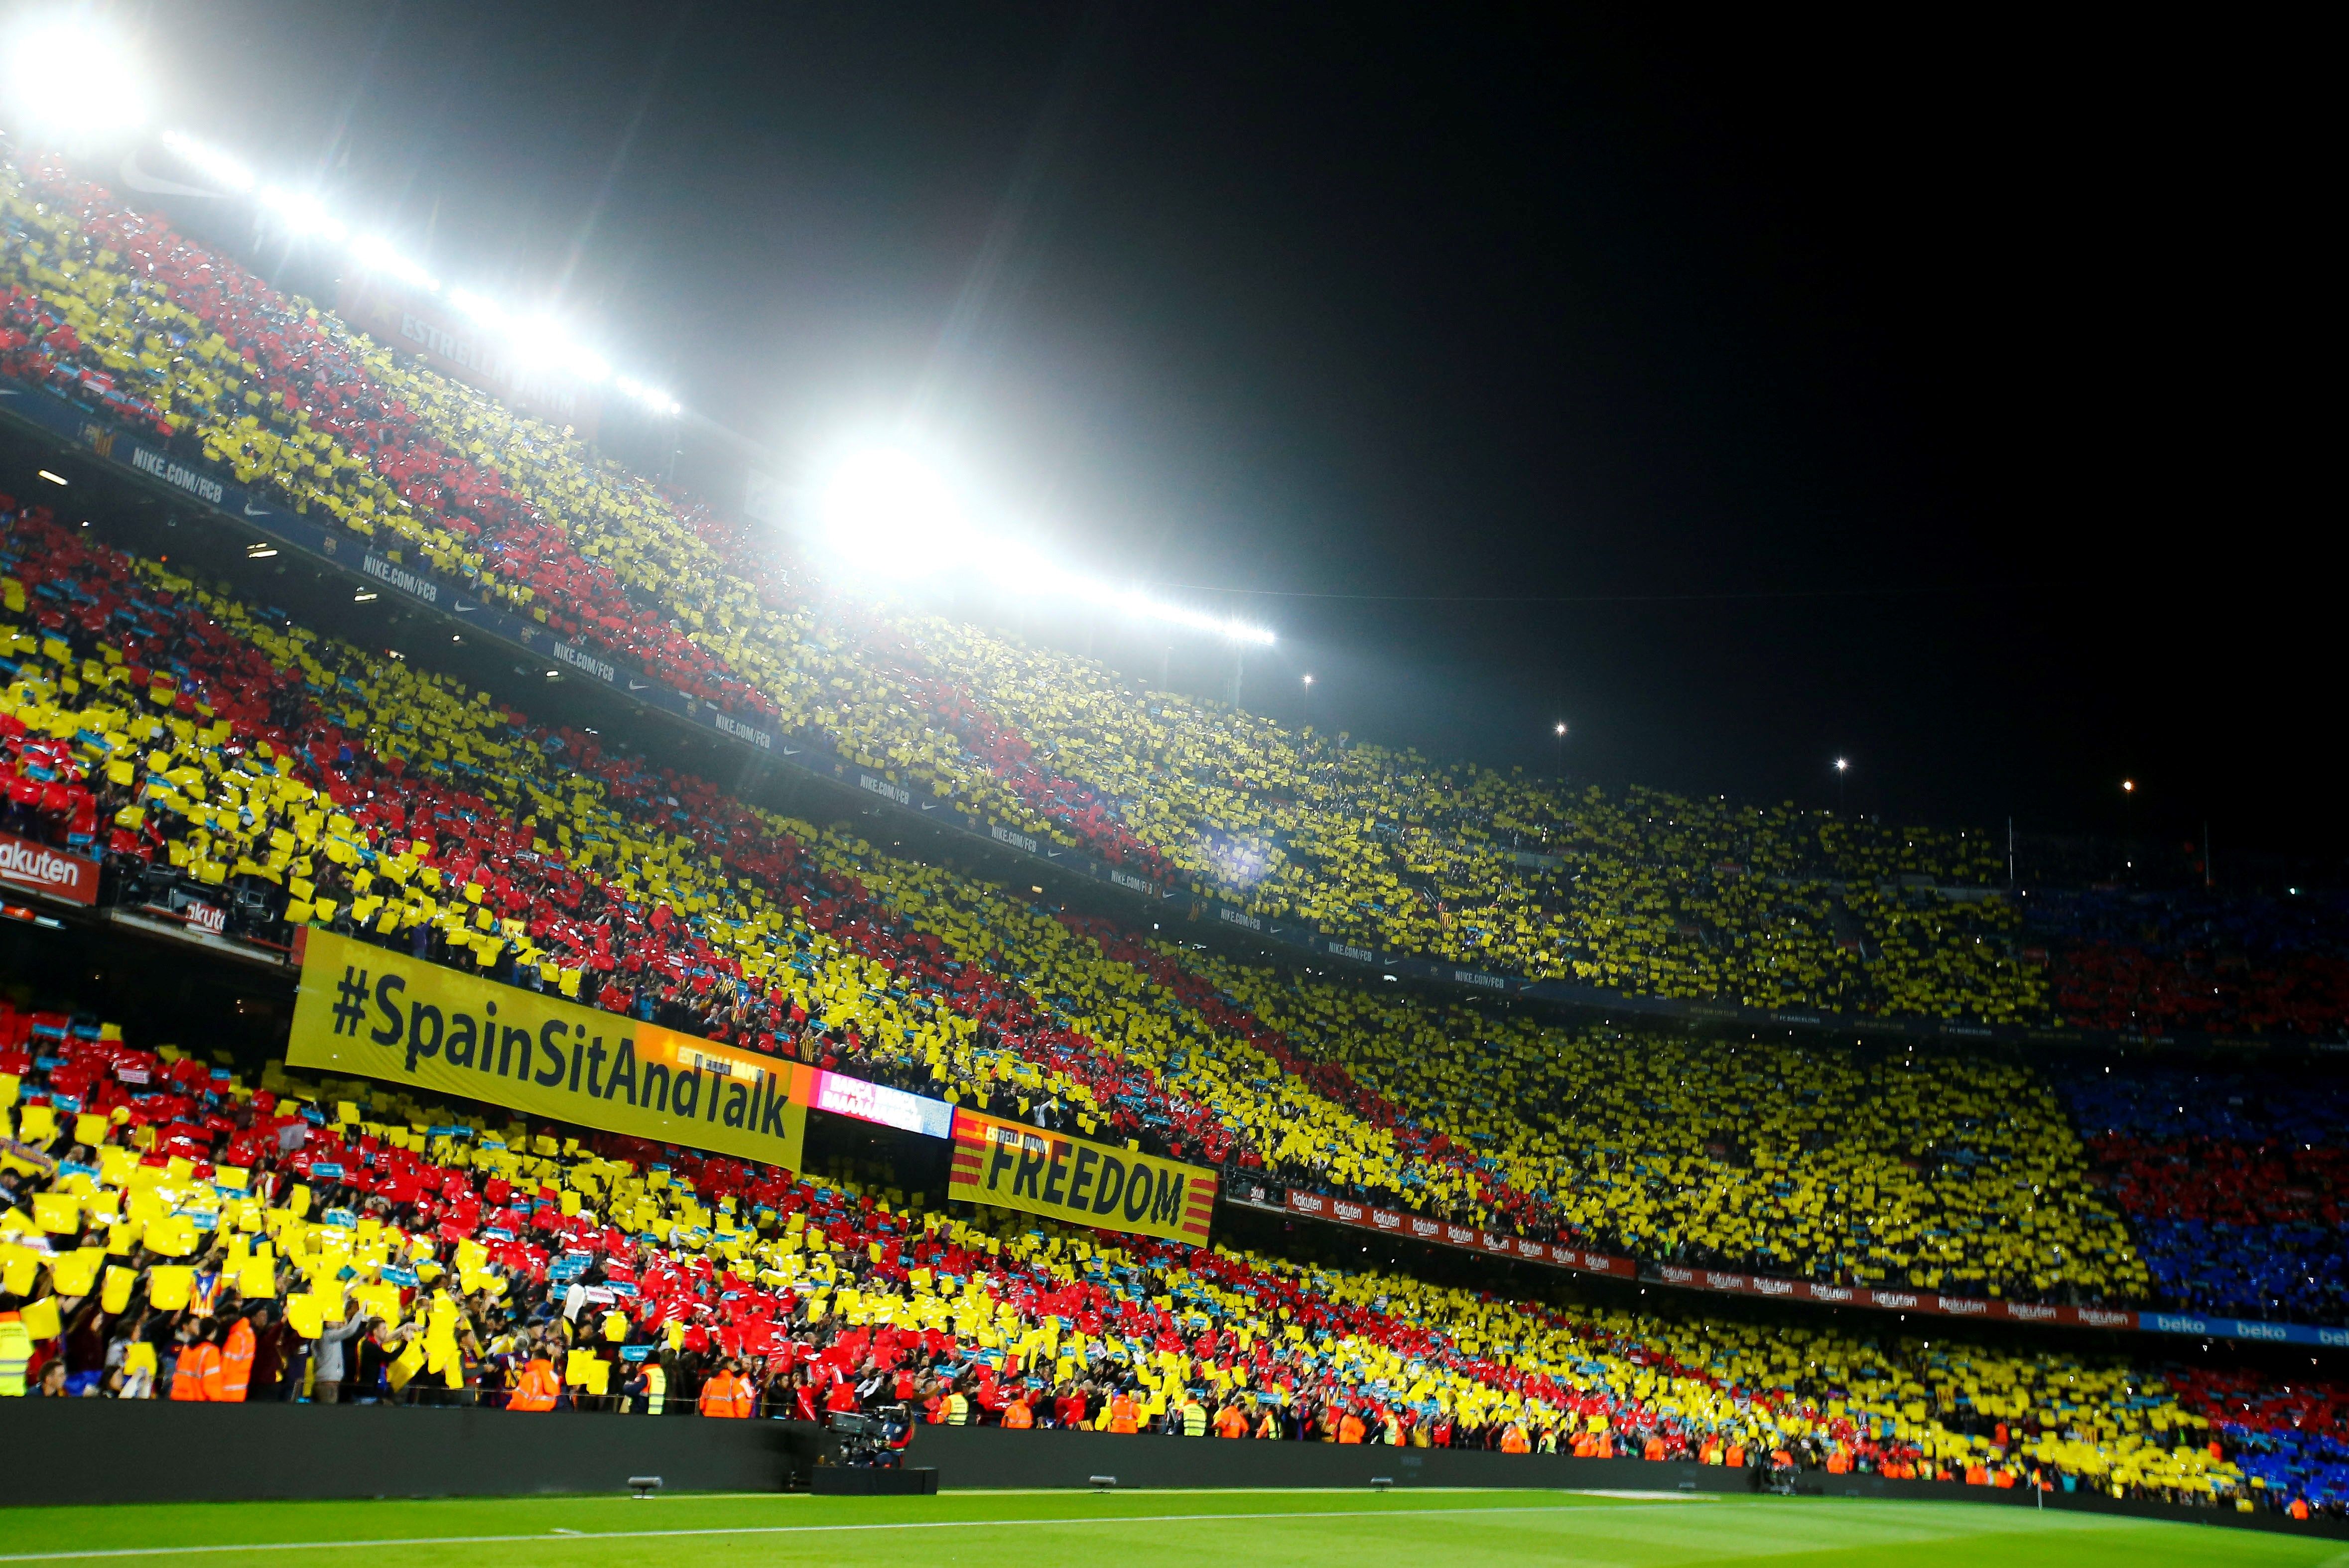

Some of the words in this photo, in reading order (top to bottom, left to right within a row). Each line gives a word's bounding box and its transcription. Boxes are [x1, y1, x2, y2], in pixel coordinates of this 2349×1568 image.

[132, 447, 222, 504] NIKE.COM/FCB
[363, 555, 437, 602] NIKE.COM/FCB
[553, 642, 614, 682] NIKE.COM/FCB
[716, 714, 770, 749] NIKE.COM/FCB
[860, 774, 909, 804] NIKE.COM/FCB
[991, 825, 1036, 852] NIKE.COM/FCB
[1111, 870, 1152, 895] NIKE.COM/FB
[1221, 908, 1261, 930] NIKE.COM/FCB
[1328, 941, 1372, 962] NIKE.COM/FCB
[1455, 971, 1504, 988] NIKE.COM/FCB
[332, 965, 789, 1139] #SpainSitAndTalk
[987, 1126, 1185, 1228] FREEDOM
[1293, 1192, 1321, 1211] Rakuten
[1333, 1201, 1362, 1220] Rakuten
[1373, 1210, 1400, 1227] Rakuten
[1412, 1219, 1438, 1235] Rakuten
[1448, 1226, 1473, 1242] Rakuten
[1518, 1240, 1542, 1256] Rakuten
[1552, 1247, 1575, 1263] Rakuten
[1585, 1254, 1609, 1270] Rakuten
[1661, 1265, 1693, 1282] Rakuten
[1706, 1272, 1743, 1288] Rakuten
[1753, 1277, 1793, 1294] Rakuten
[1810, 1284, 1853, 1301] Rakuten
[1872, 1291, 1917, 1307] Rakuten
[1938, 1297, 1986, 1313] Rakuten
[2008, 1303, 2057, 1319] Rakuten
[2158, 1315, 2206, 1333] beko
[2237, 1320, 2286, 1340] beko
